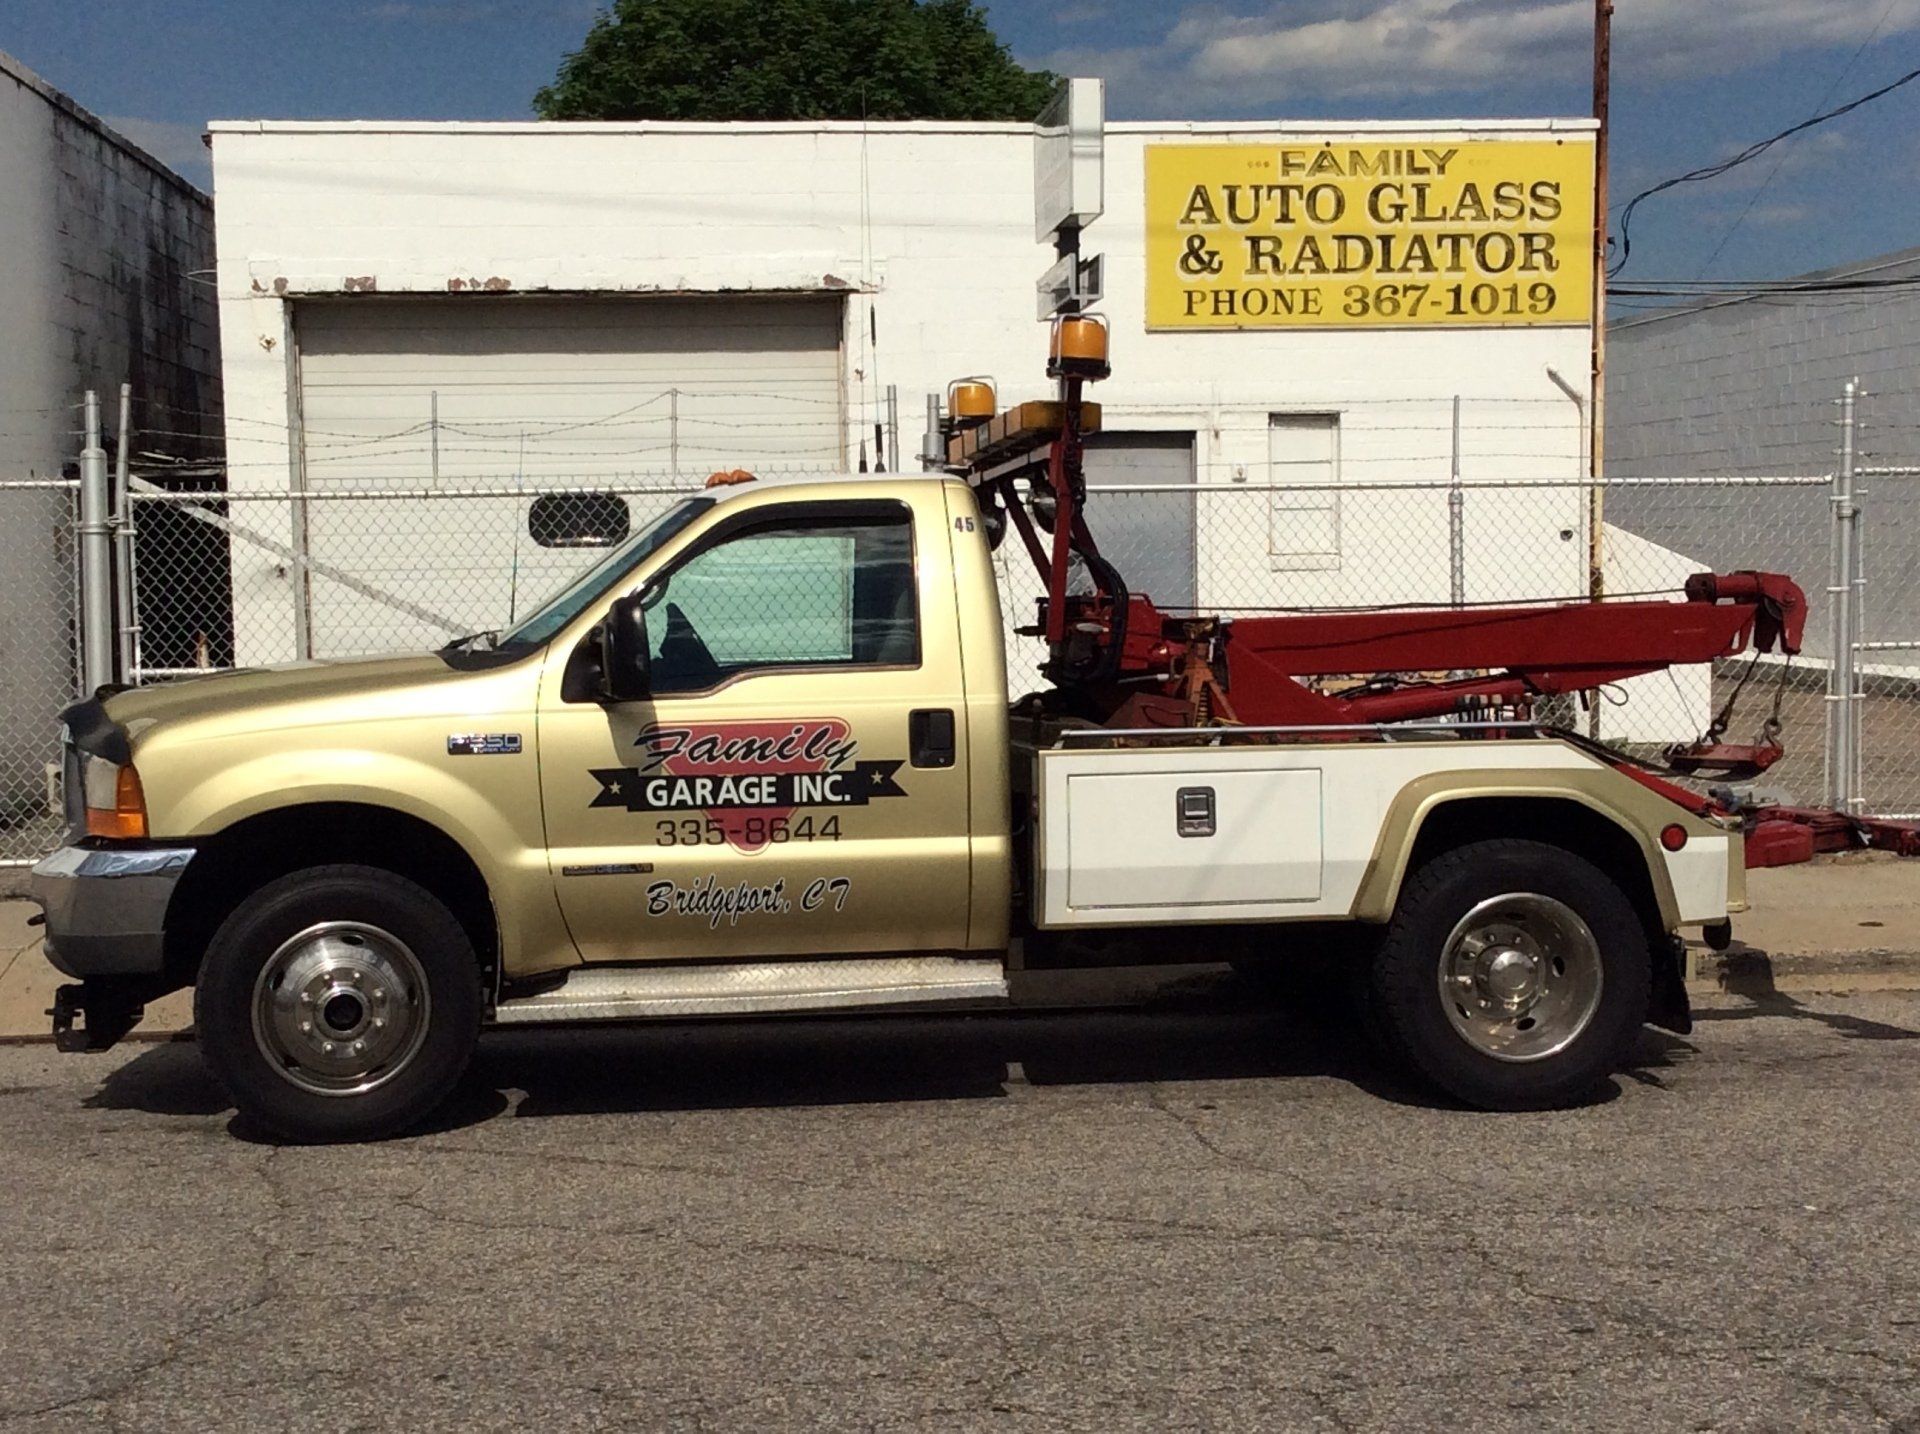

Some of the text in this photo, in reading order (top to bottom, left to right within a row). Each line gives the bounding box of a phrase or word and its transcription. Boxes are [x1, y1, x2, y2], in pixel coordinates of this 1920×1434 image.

[1278, 148, 1459, 179] FAMILY
[1178, 180, 1563, 226] AUTO GLASS
[1179, 232, 1561, 276] & RADIATOR
[1183, 282, 1557, 318] PHONE 367-1019
[954, 516, 975, 533] 45
[633, 724, 858, 774] Family
[645, 773, 851, 807] GARAGE INC.
[655, 814, 843, 847] 335-8644
[646, 874, 851, 929] Bridgeport, CT
